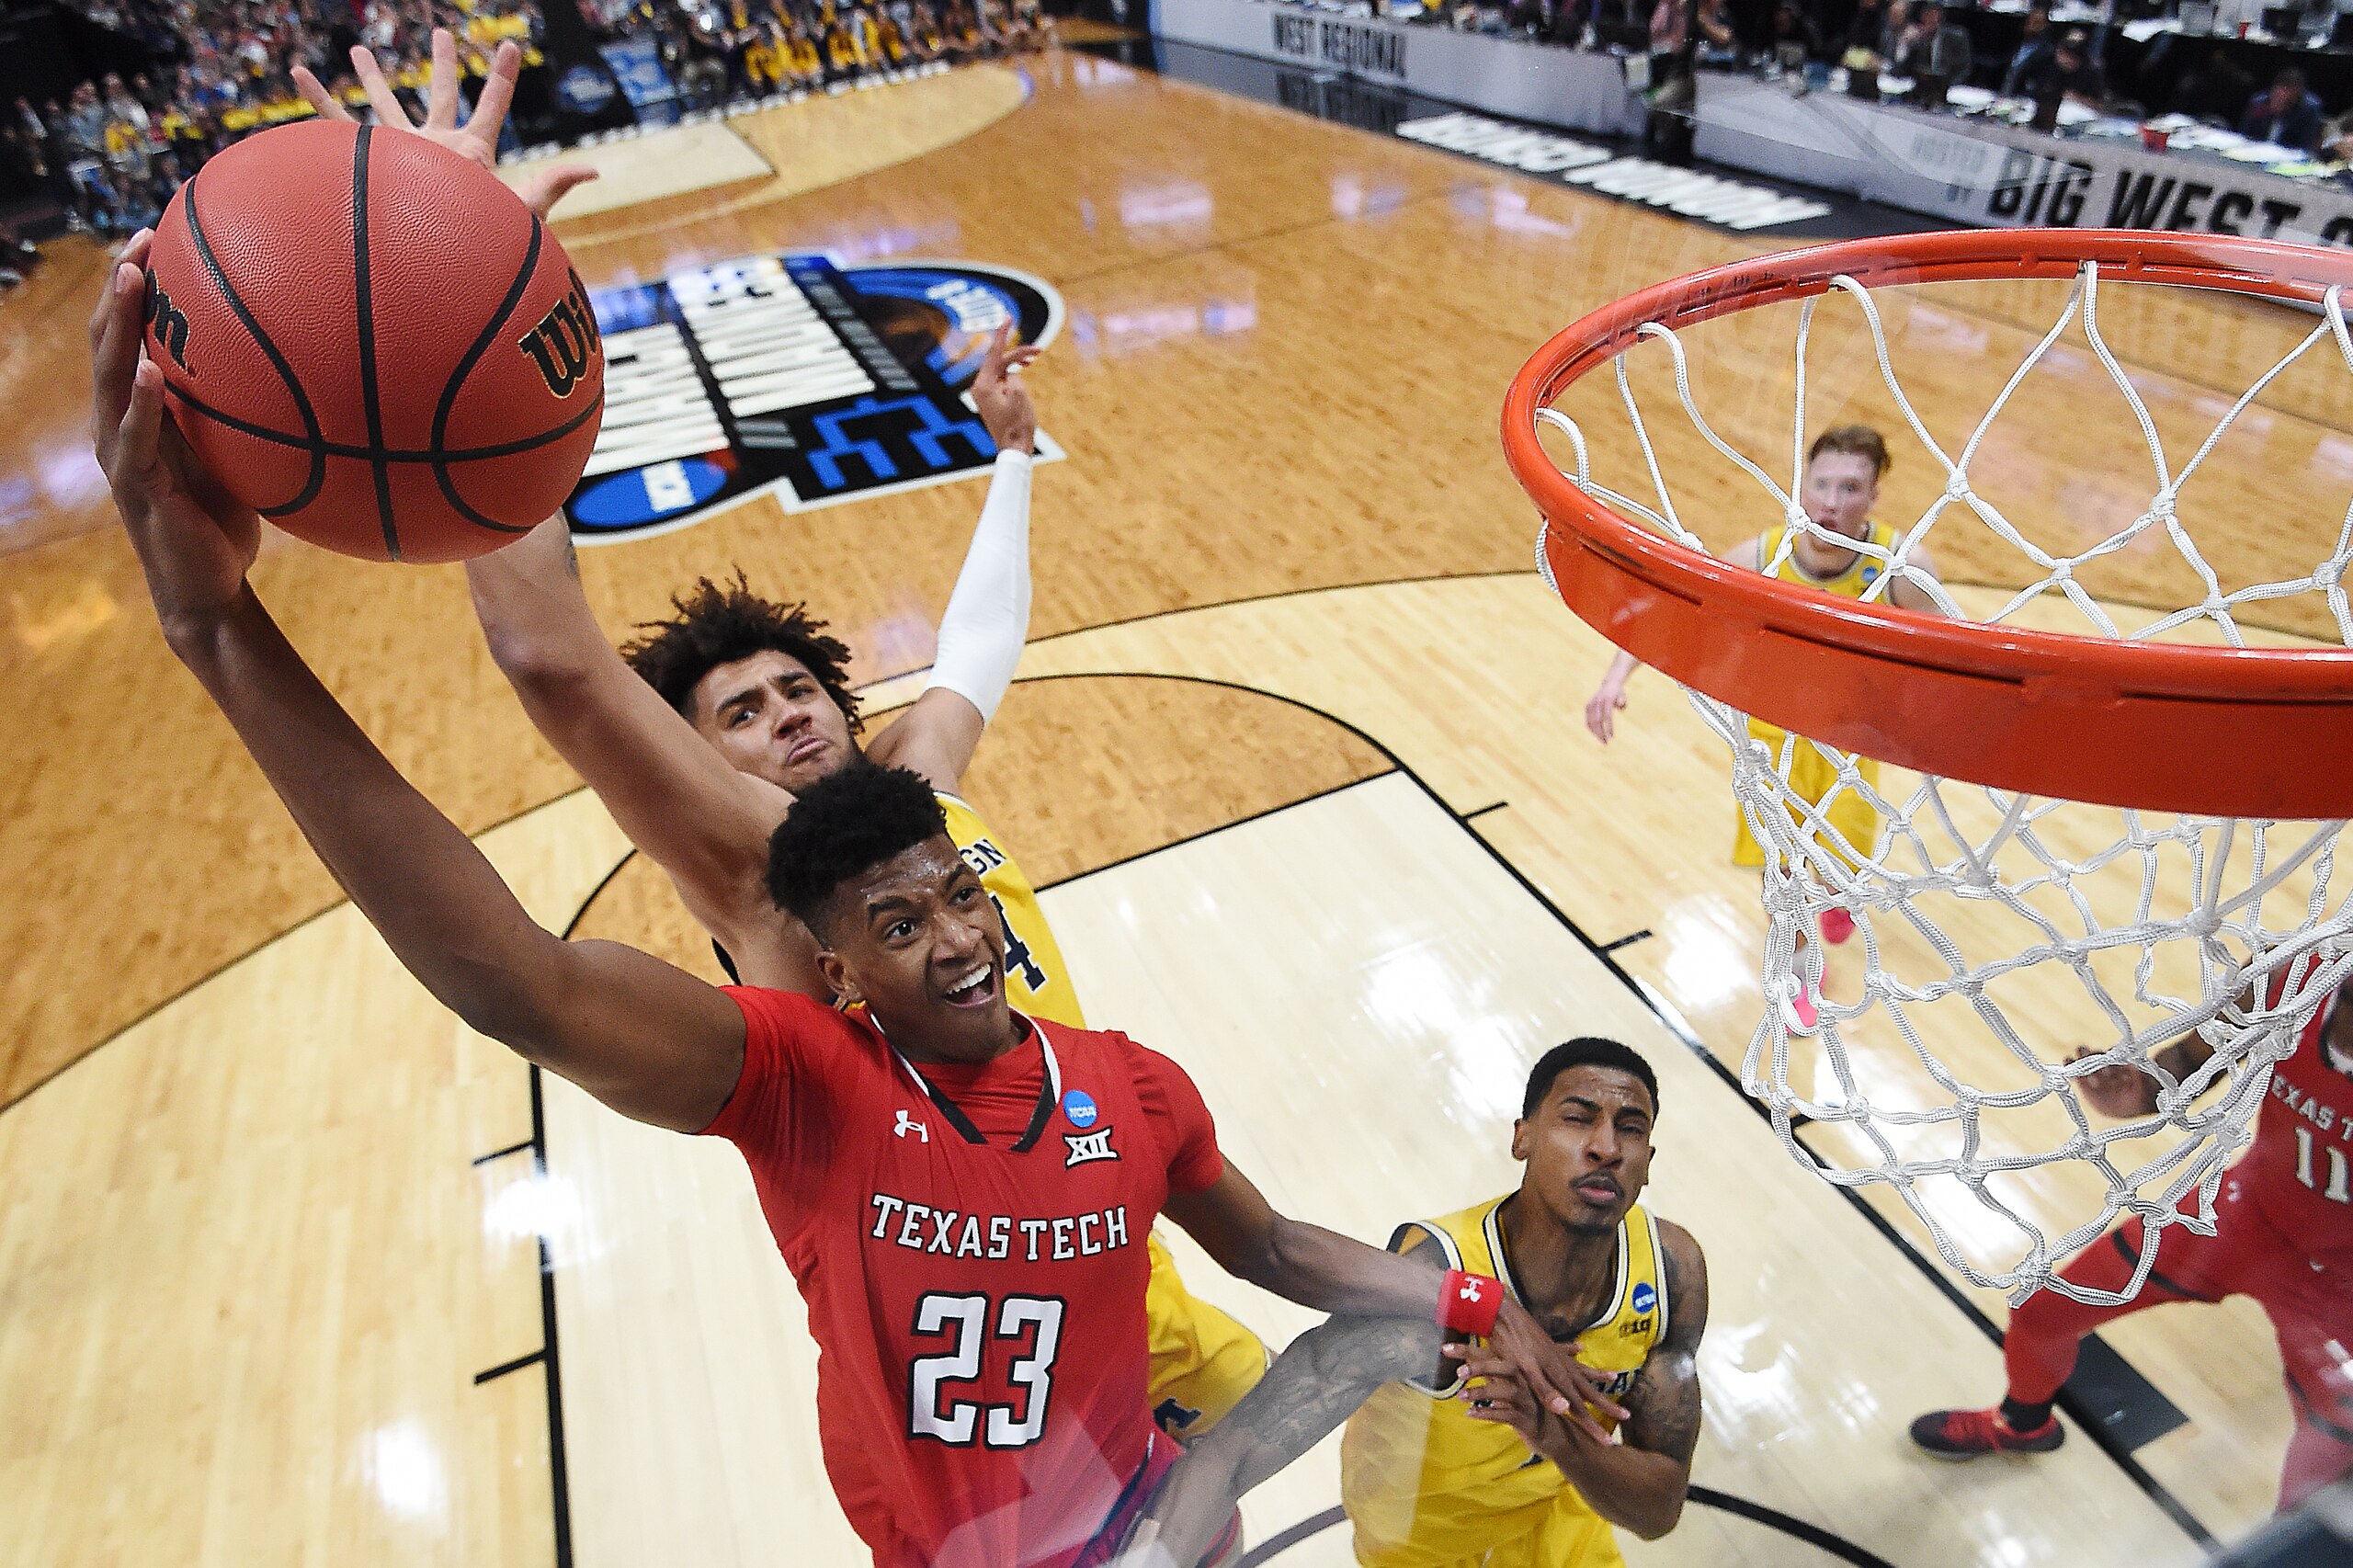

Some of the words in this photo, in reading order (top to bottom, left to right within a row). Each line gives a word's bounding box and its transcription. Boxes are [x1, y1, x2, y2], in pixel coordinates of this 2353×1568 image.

[1988, 148, 2096, 227] BIG
[2105, 169, 2302, 238] WEST
[2271, 1074, 2336, 1131] EXAS
[2294, 1126, 2352, 1205] 11
[870, 1192, 1012, 1262] TEXAS
[1017, 1205, 1130, 1263] TECH
[907, 1290, 1067, 1451] 23
